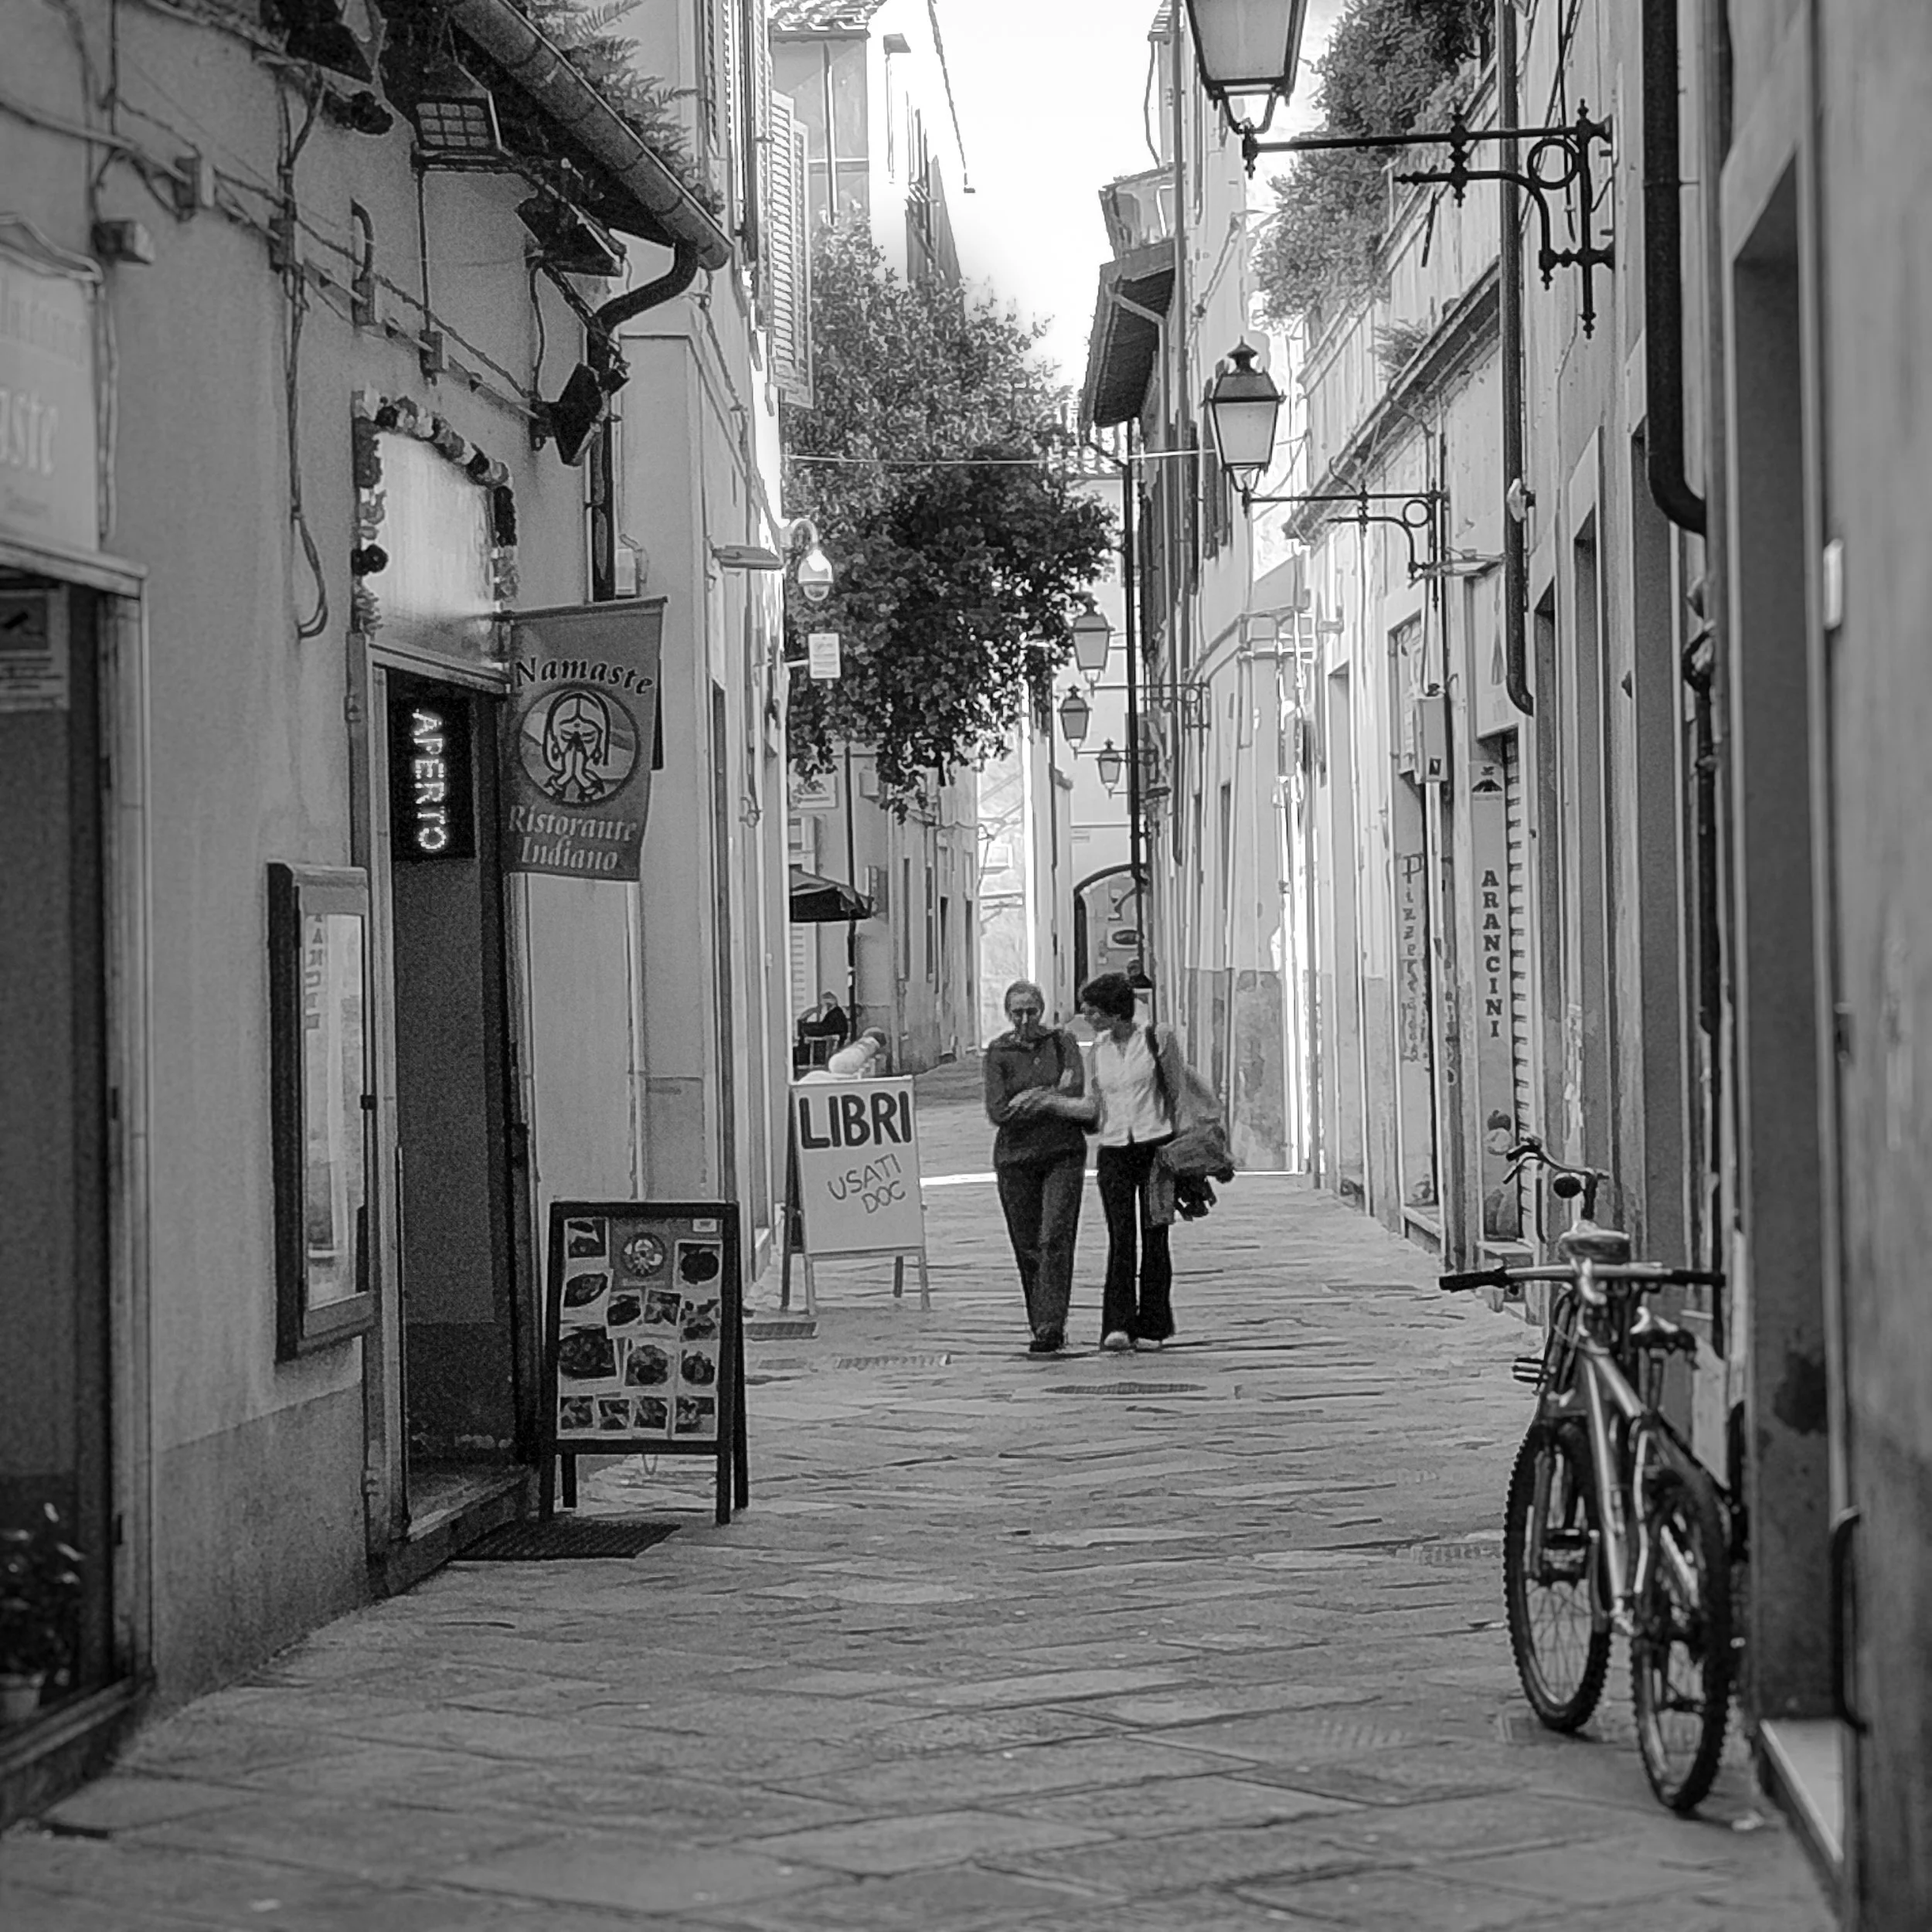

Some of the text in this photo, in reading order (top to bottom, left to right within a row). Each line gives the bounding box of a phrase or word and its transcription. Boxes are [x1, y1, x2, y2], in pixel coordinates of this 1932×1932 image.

[515, 657, 653, 695] Namaste
[412, 708, 446, 849] APERTO
[509, 805, 637, 841] Ristorante
[521, 836, 617, 871] Indiano
[1481, 869, 1502, 1038] ARANCINI
[799, 1091, 912, 1149] LIBRI
[828, 1153, 901, 1200] USATI
[861, 1180, 906, 1213] DOC
